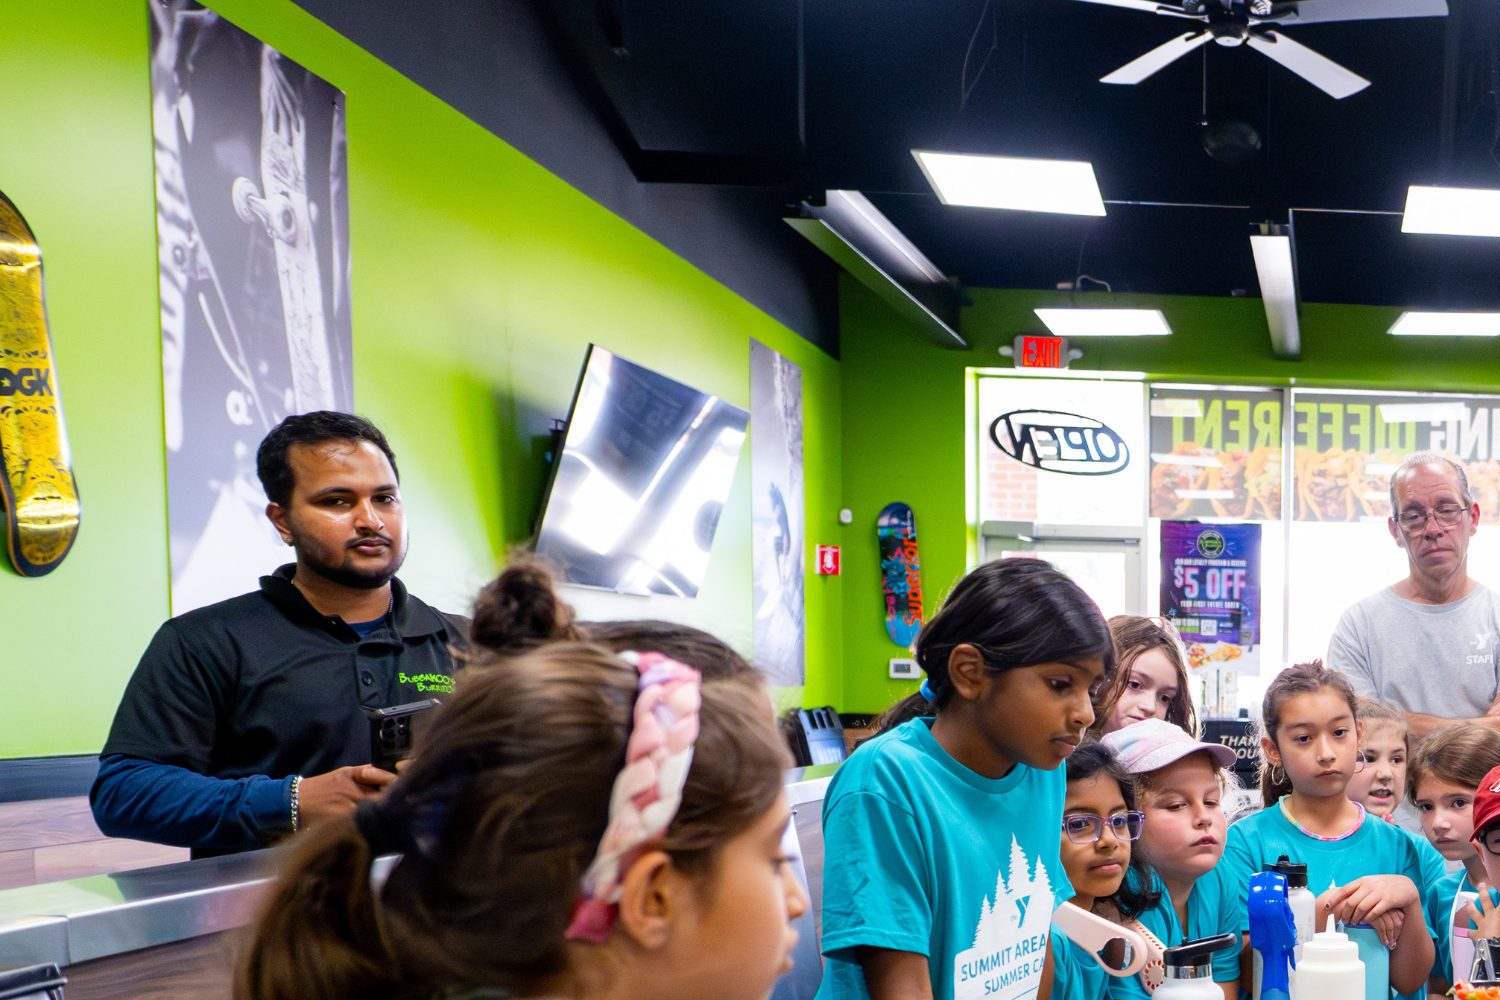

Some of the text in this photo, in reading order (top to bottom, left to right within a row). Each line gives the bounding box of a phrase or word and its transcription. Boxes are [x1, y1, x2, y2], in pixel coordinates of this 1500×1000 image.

[1023, 336, 1063, 368] EXIT
[0, 367, 54, 396] DGK
[902, 536, 924, 627] Superior
[1174, 565, 1247, 600] $5 OFF
[961, 933, 1046, 982] SUMMIT AREA
[984, 962, 1030, 996] SUMMER
